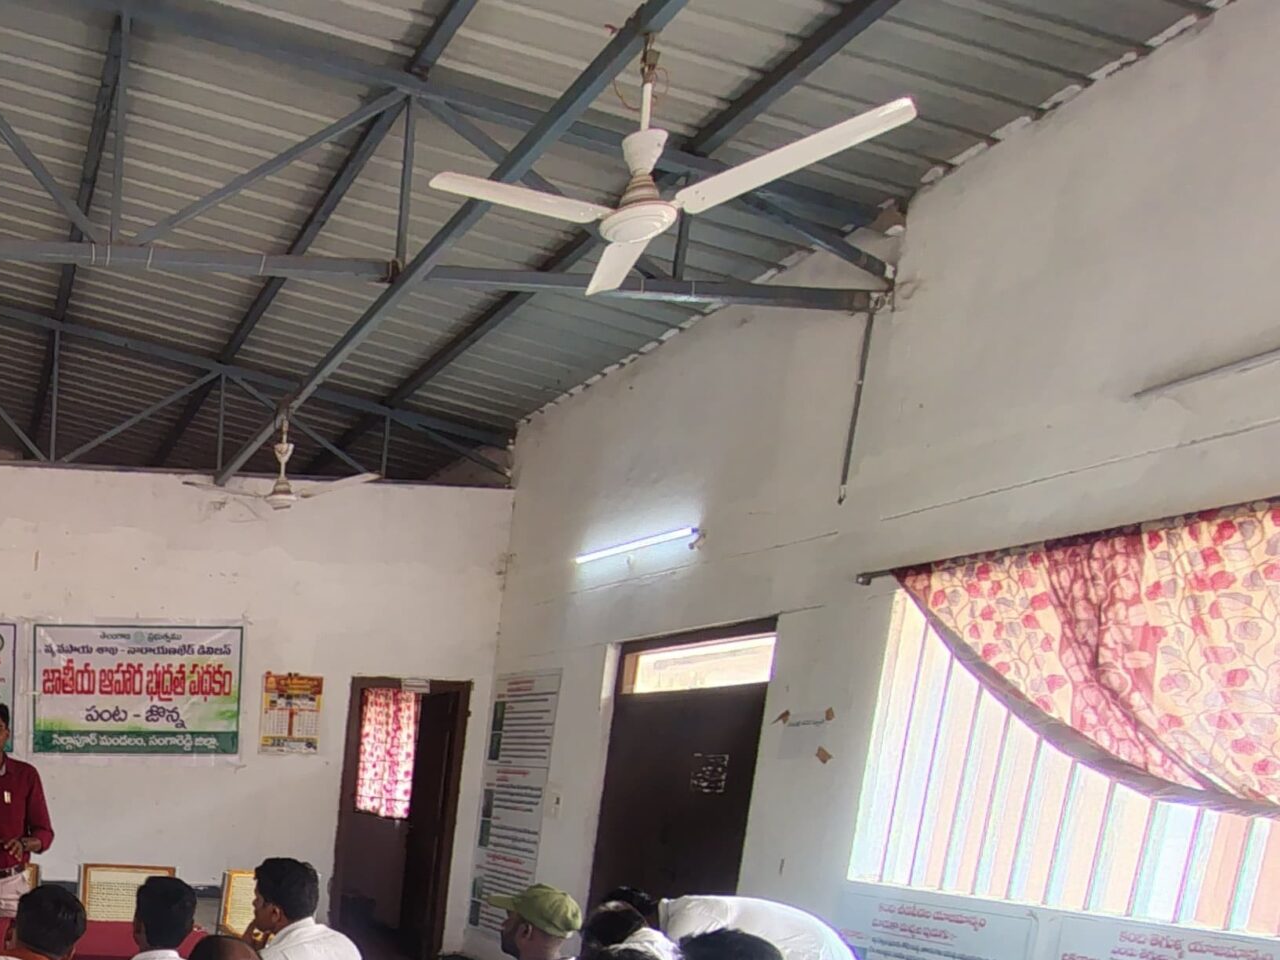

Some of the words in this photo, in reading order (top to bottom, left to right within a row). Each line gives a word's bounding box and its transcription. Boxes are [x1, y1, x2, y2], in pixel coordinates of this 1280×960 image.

[42, 658, 96, 696] జాతీయ
[99, 662, 143, 696] ఆహార
[146, 662, 186, 702] భద్రత
[189, 662, 233, 703] పథకం
[85, 705, 128, 723] పంట
[145, 704, 187, 729] జొన్న
